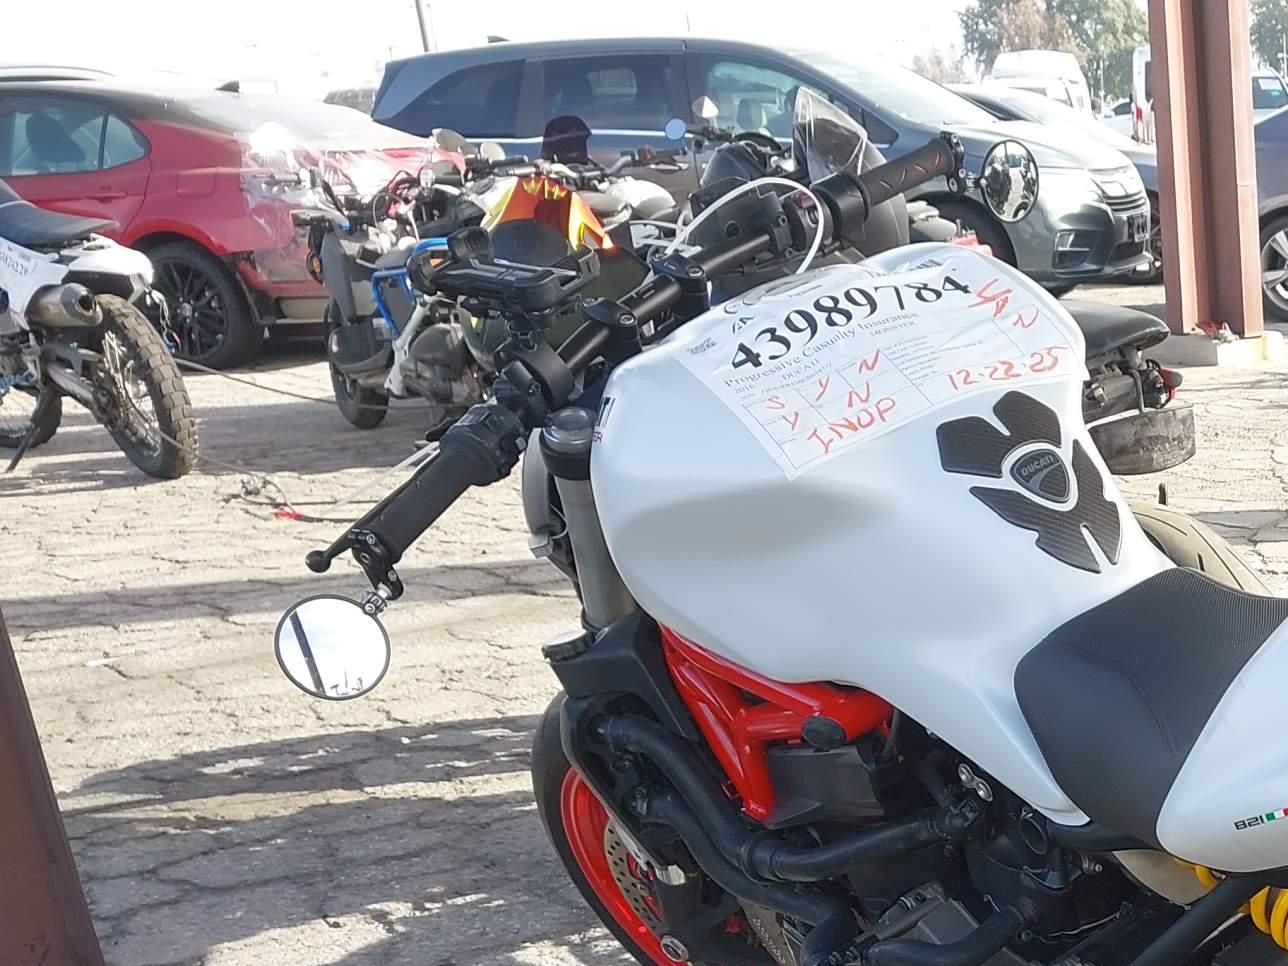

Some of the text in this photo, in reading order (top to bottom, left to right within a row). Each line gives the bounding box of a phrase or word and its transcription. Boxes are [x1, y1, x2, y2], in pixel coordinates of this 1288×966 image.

[725, 355, 803, 389] Progressive
[858, 311, 920, 331] Insurance
[732, 276, 972, 370] 43989784
[781, 358, 821, 382] DUCATI
[870, 320, 917, 337] MONSTER
[1020, 455, 1056, 476] DUCATI
[1233, 814, 1265, 831] 821
